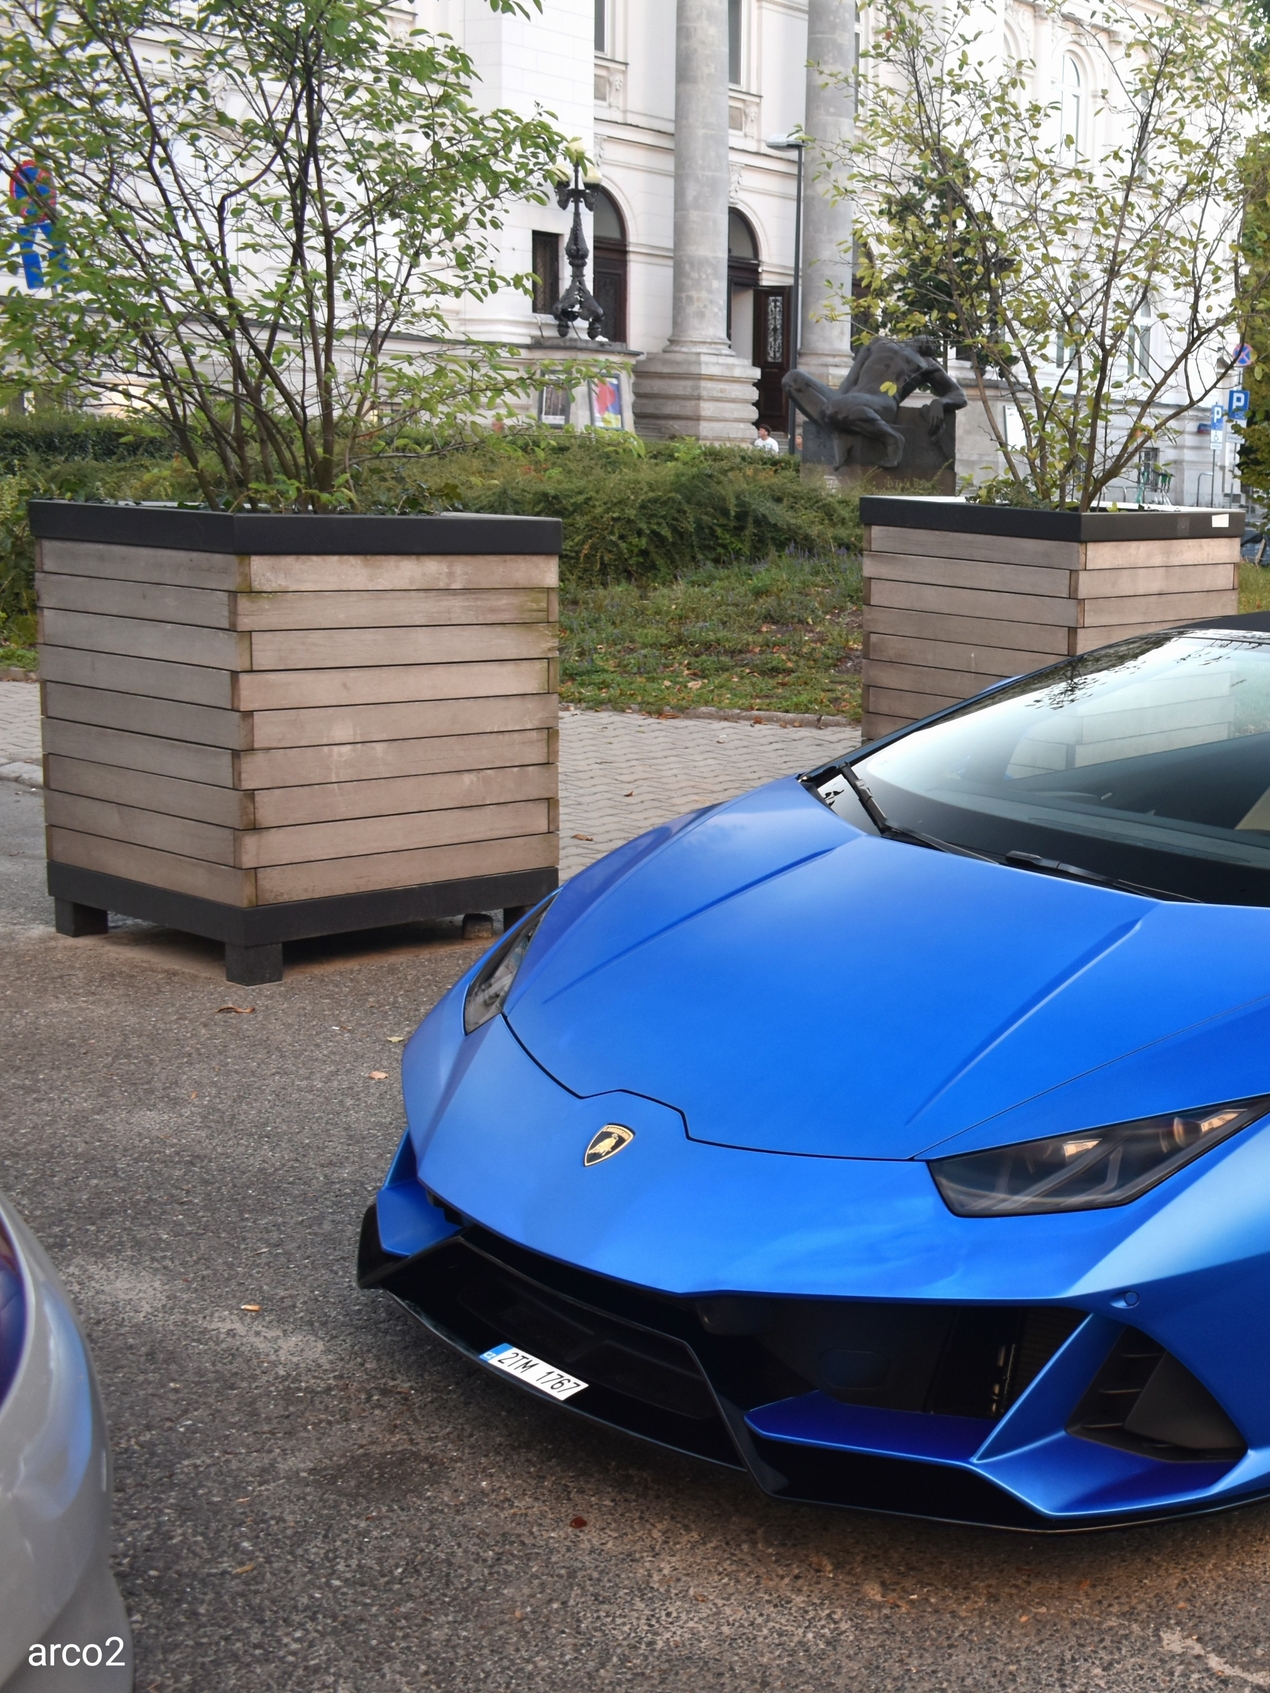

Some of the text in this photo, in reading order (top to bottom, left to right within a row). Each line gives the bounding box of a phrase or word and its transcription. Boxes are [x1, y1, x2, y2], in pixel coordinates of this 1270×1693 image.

[1214, 407, 1222, 423] P
[498, 1352, 581, 1393] 2TM 1767
